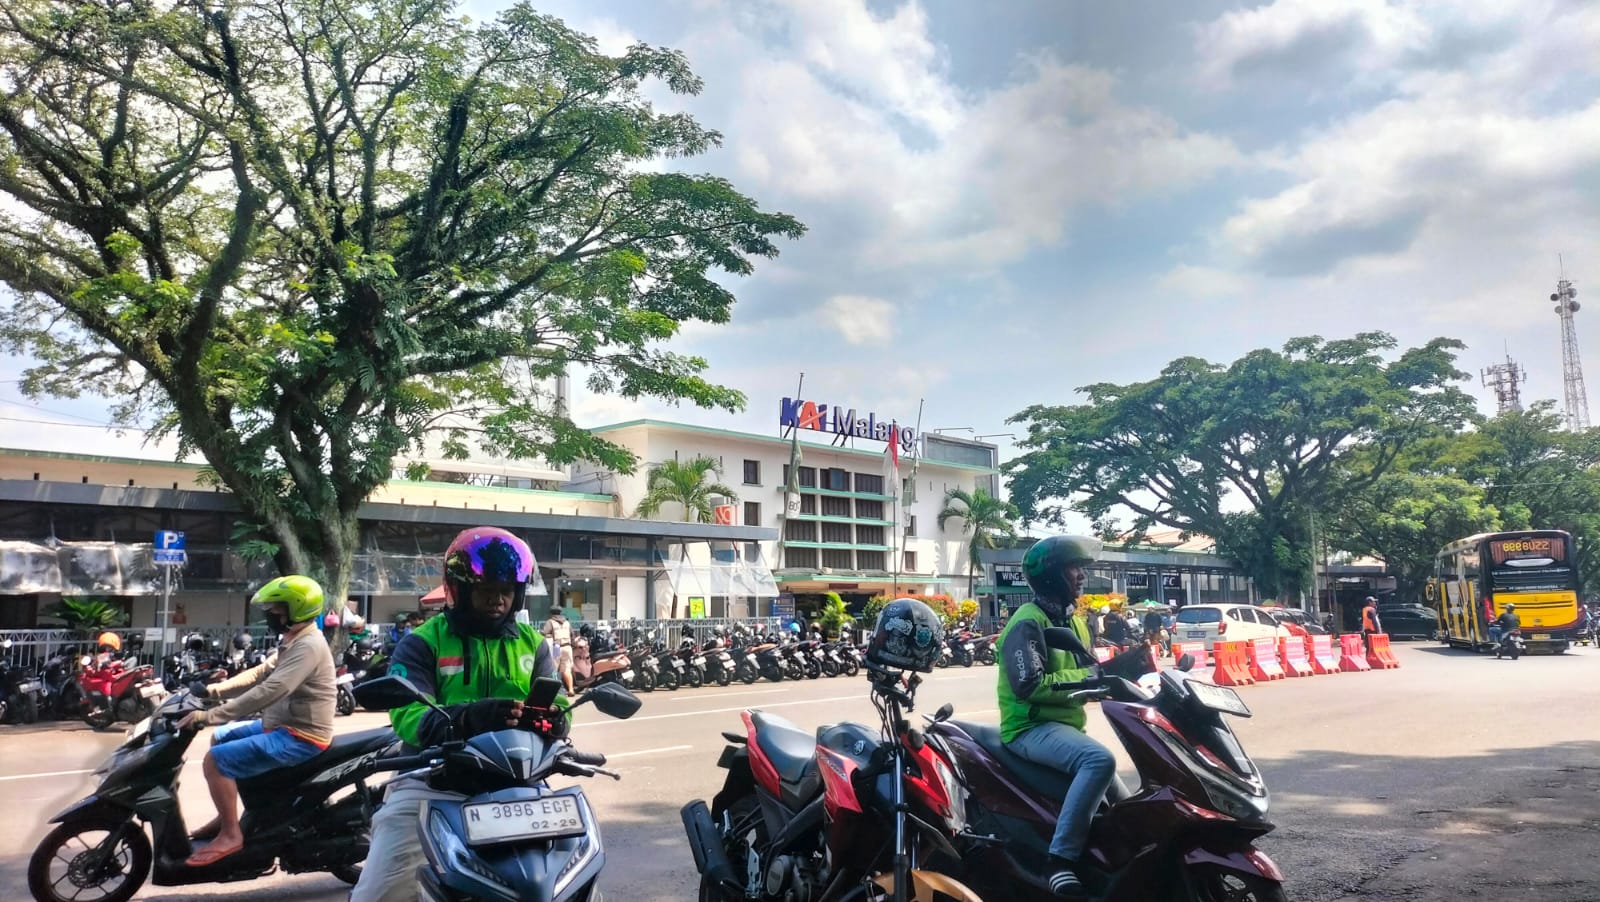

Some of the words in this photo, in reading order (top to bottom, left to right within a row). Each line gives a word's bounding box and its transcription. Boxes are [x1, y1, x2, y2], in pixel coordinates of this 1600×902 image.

[780, 397, 827, 431] KAI
[833, 405, 915, 452] Malang
[163, 532, 178, 549] P
[1002, 572, 1020, 581] WING
[470, 808, 481, 822] N
[492, 803, 534, 819] 3896
[542, 800, 572, 814] EGF
